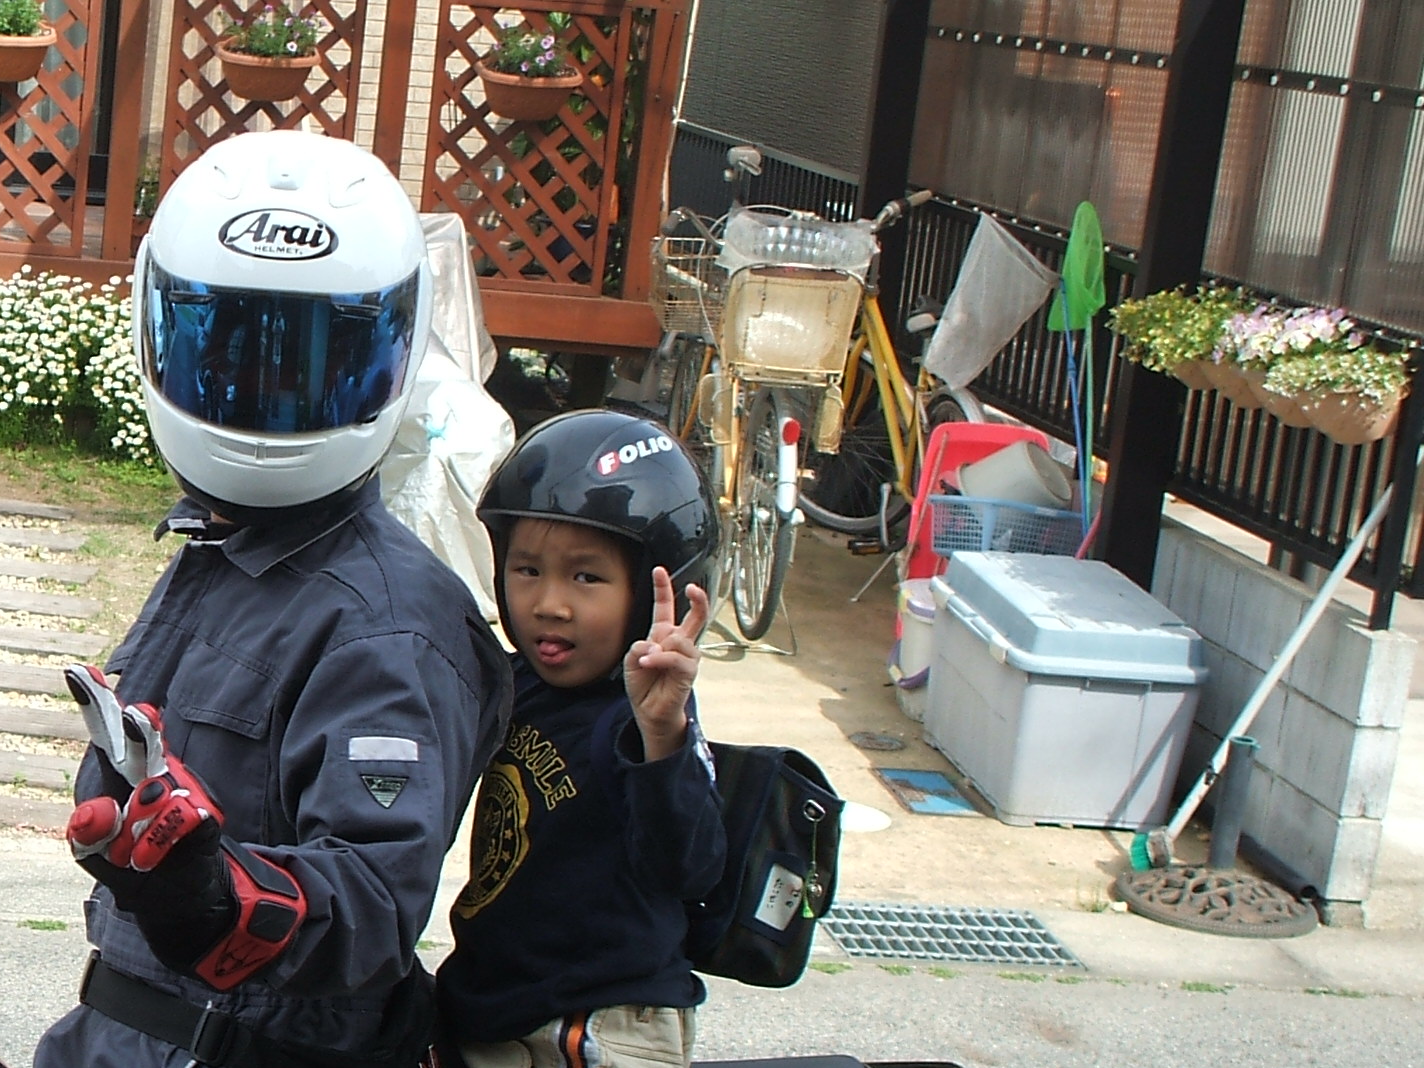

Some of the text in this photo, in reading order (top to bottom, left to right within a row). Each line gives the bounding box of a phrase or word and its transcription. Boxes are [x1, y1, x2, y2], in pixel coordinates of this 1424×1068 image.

[225, 212, 326, 249] Arai
[254, 245, 300, 255] HELMET
[598, 435, 674, 476] FOLIO
